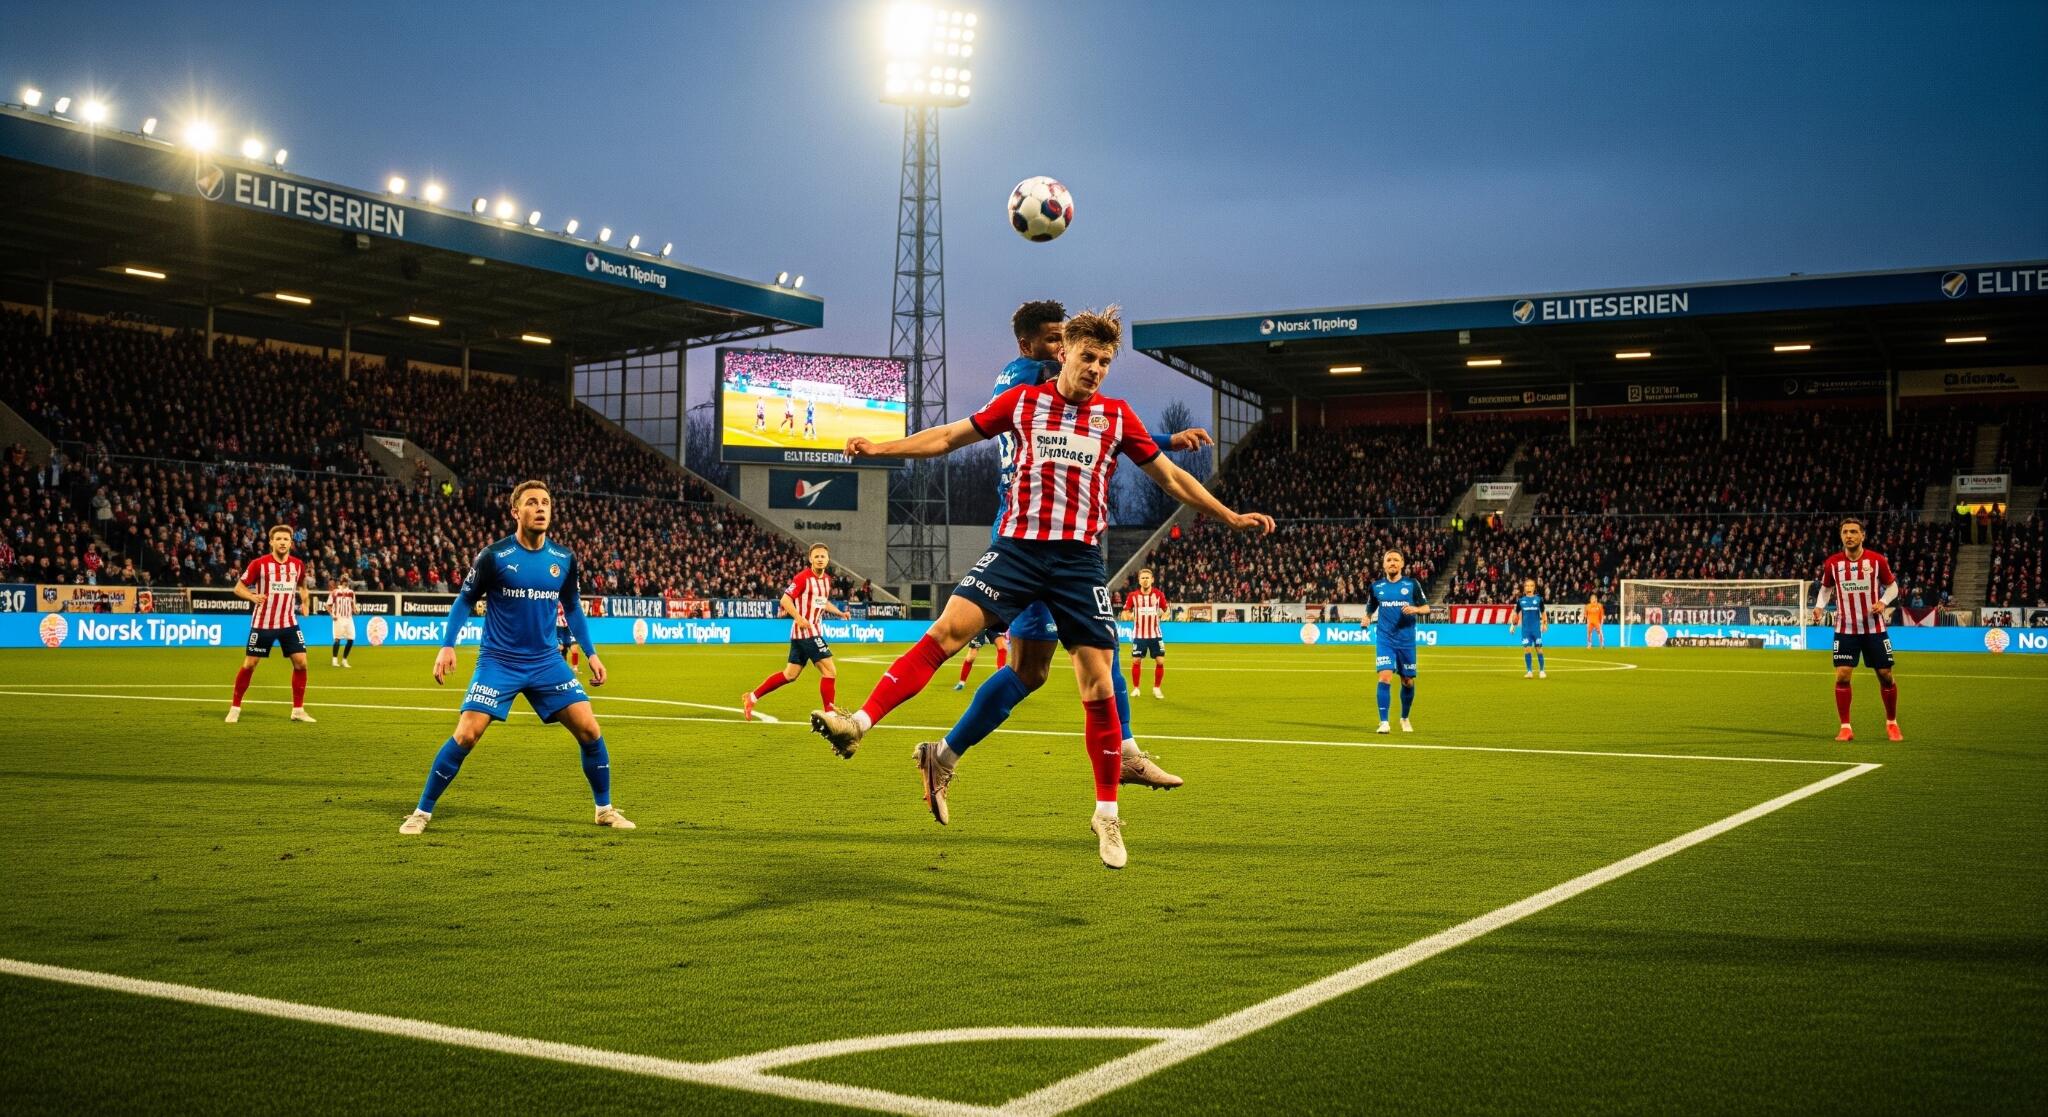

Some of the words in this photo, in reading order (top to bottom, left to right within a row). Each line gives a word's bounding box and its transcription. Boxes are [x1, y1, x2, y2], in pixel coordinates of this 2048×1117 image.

[235, 172, 404, 237] ELITESERIEN
[629, 265, 667, 289] Tipping
[1542, 292, 1688, 321] ELITESERIEN
[1277, 320, 1310, 333] Norsk
[78, 618, 143, 641] Norsk
[147, 618, 222, 646] Tipping
[394, 621, 440, 641] Norsk
[652, 623, 684, 640] Norsk
[686, 623, 731, 642] Tipping
[851, 623, 885, 642] Tipping
[1326, 627, 1371, 643] Norsk
